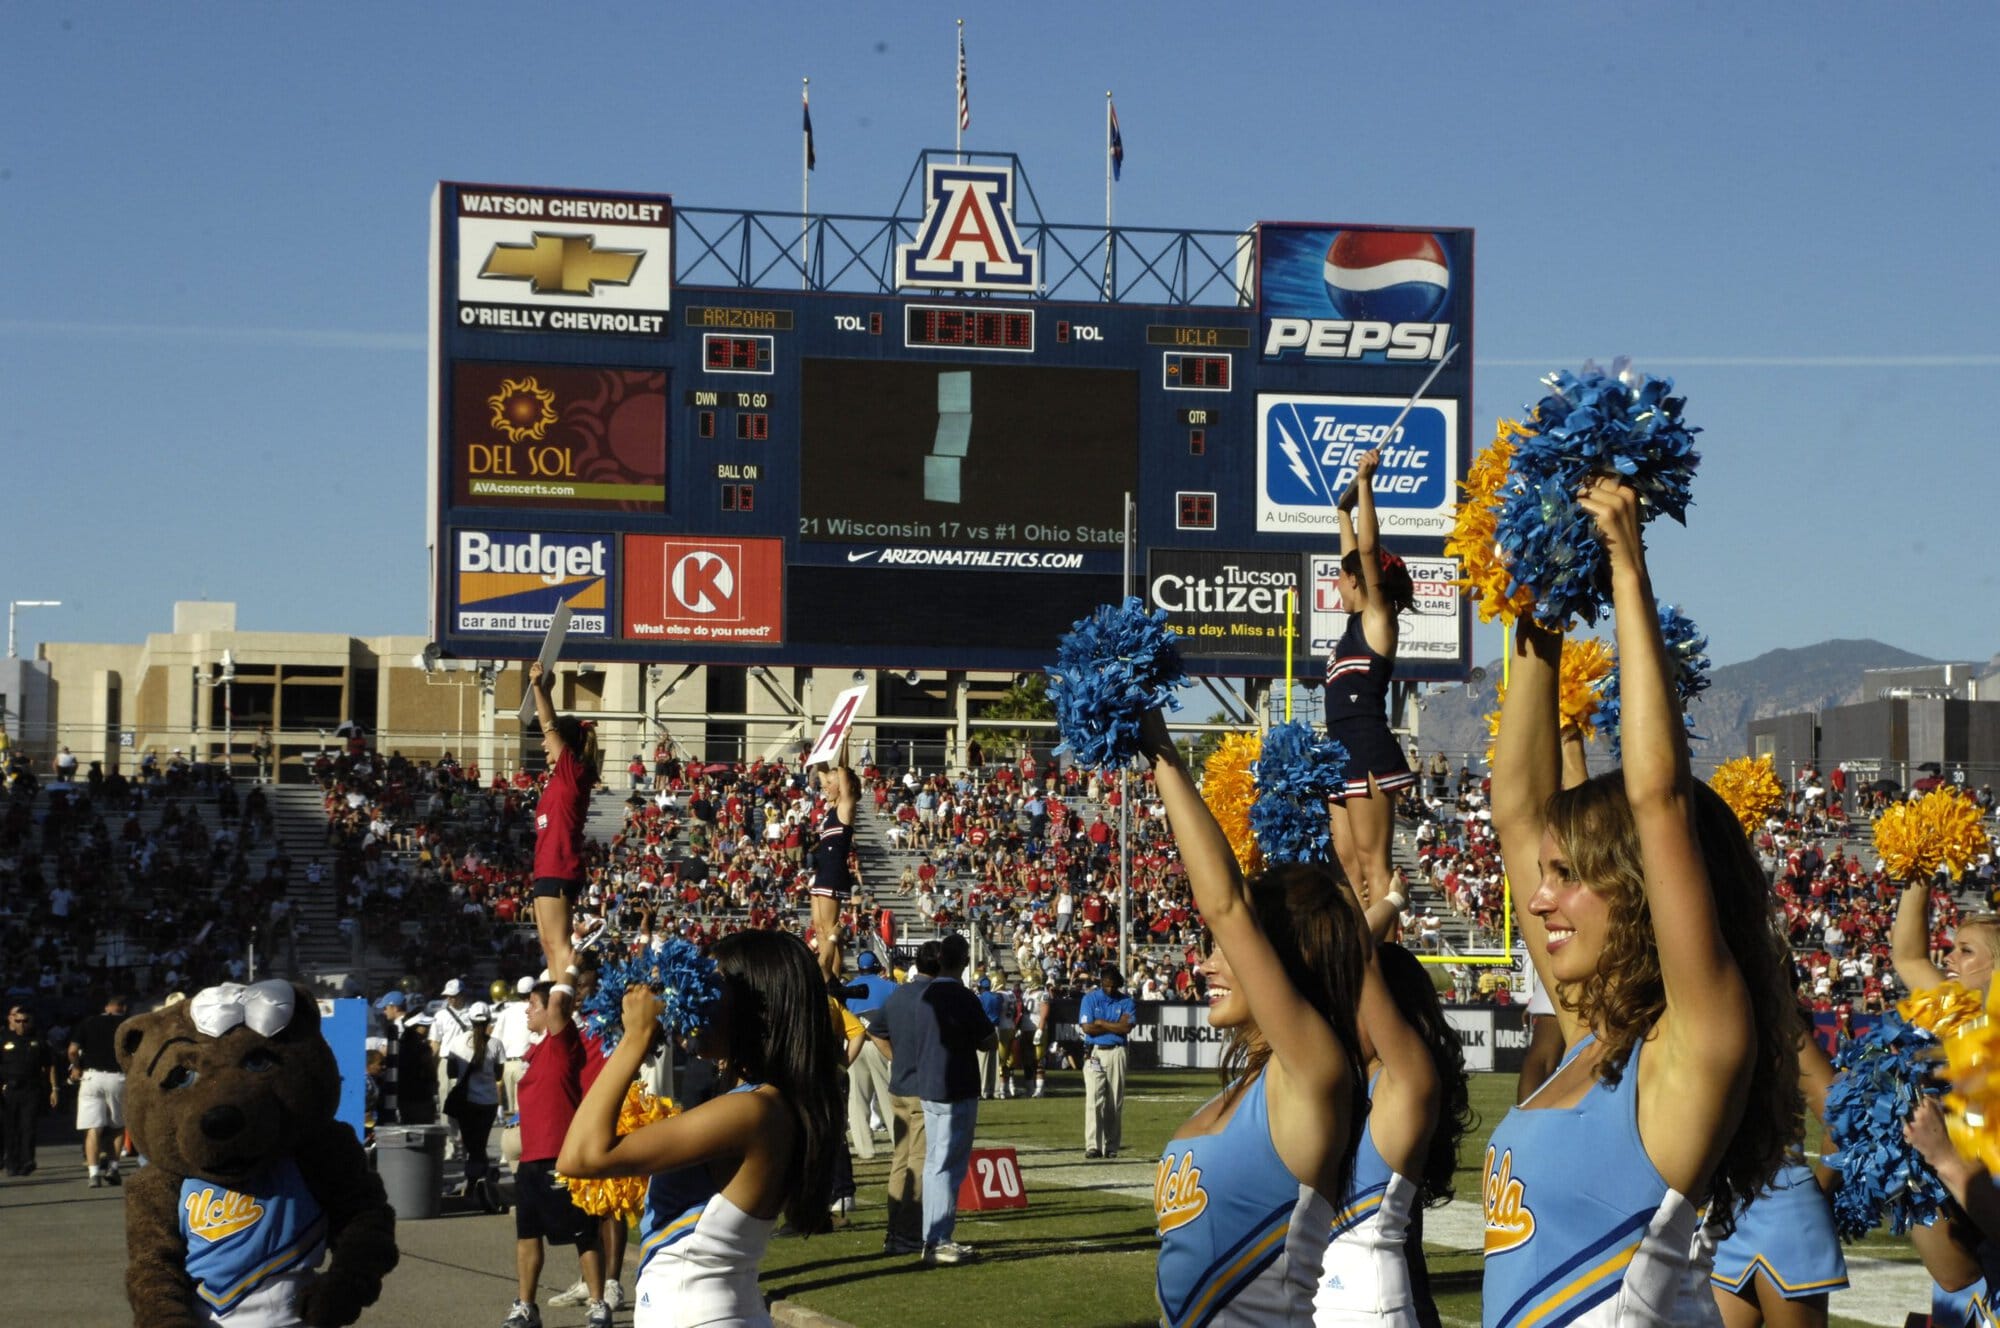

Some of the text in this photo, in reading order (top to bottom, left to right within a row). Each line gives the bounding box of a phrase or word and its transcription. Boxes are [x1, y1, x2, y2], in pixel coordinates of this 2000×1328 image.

[462, 194, 663, 221] WATSON CHEVROLET
[460, 307, 663, 333] O'RIELLY CHEVROLET
[703, 309, 776, 329] ARIZONA
[834, 316, 866, 331] TOL
[926, 311, 1030, 346] 15:00
[1073, 326, 1104, 340] TOL
[1175, 328, 1217, 345] UCLA
[1264, 318, 1451, 361] PEPSI
[706, 338, 756, 369] 34
[695, 392, 717, 406] DWN
[738, 393, 767, 408] TO GO
[745, 413, 768, 440] 10
[1188, 410, 1207, 424] QTR
[1311, 415, 1405, 443] Tucson
[468, 444, 577, 477] DEL SOL
[1320, 442, 1429, 469] Eletric
[718, 464, 757, 480] BALL ON
[1331, 467, 1429, 494] Pwer
[473, 482, 575, 496] AVAconcerts.com
[1265, 511, 1275, 523] A
[1278, 512, 1340, 524] UniSource
[1388, 514, 1446, 529] Company
[827, 518, 932, 538] Wisconsin
[938, 523, 960, 539] 17
[966, 526, 989, 540] vs
[995, 523, 1017, 541] #1
[1024, 524, 1071, 542] Ohio
[1076, 526, 1125, 544] State
[459, 531, 606, 585] Budget
[878, 548, 1084, 569] ARIZONAATHLETICS.COM
[1223, 565, 1297, 586] Tucson
[1151, 574, 1300, 615] Citizen
[1424, 600, 1451, 610] CARE
[461, 616, 487, 628] car
[490, 615, 516, 629] and
[633, 624, 770, 638] What else do you need?
[1187, 626, 1196, 635] a
[1199, 623, 1227, 638] day.
[1230, 624, 1263, 636] Miss
[1266, 627, 1275, 637] a
[813, 695, 860, 755] A
[1953, 771, 1965, 783] 30
[1164, 1025, 1223, 1043] MUSCLE
[976, 1157, 1020, 1199] 20
[185, 1188, 264, 1240] Ucla
